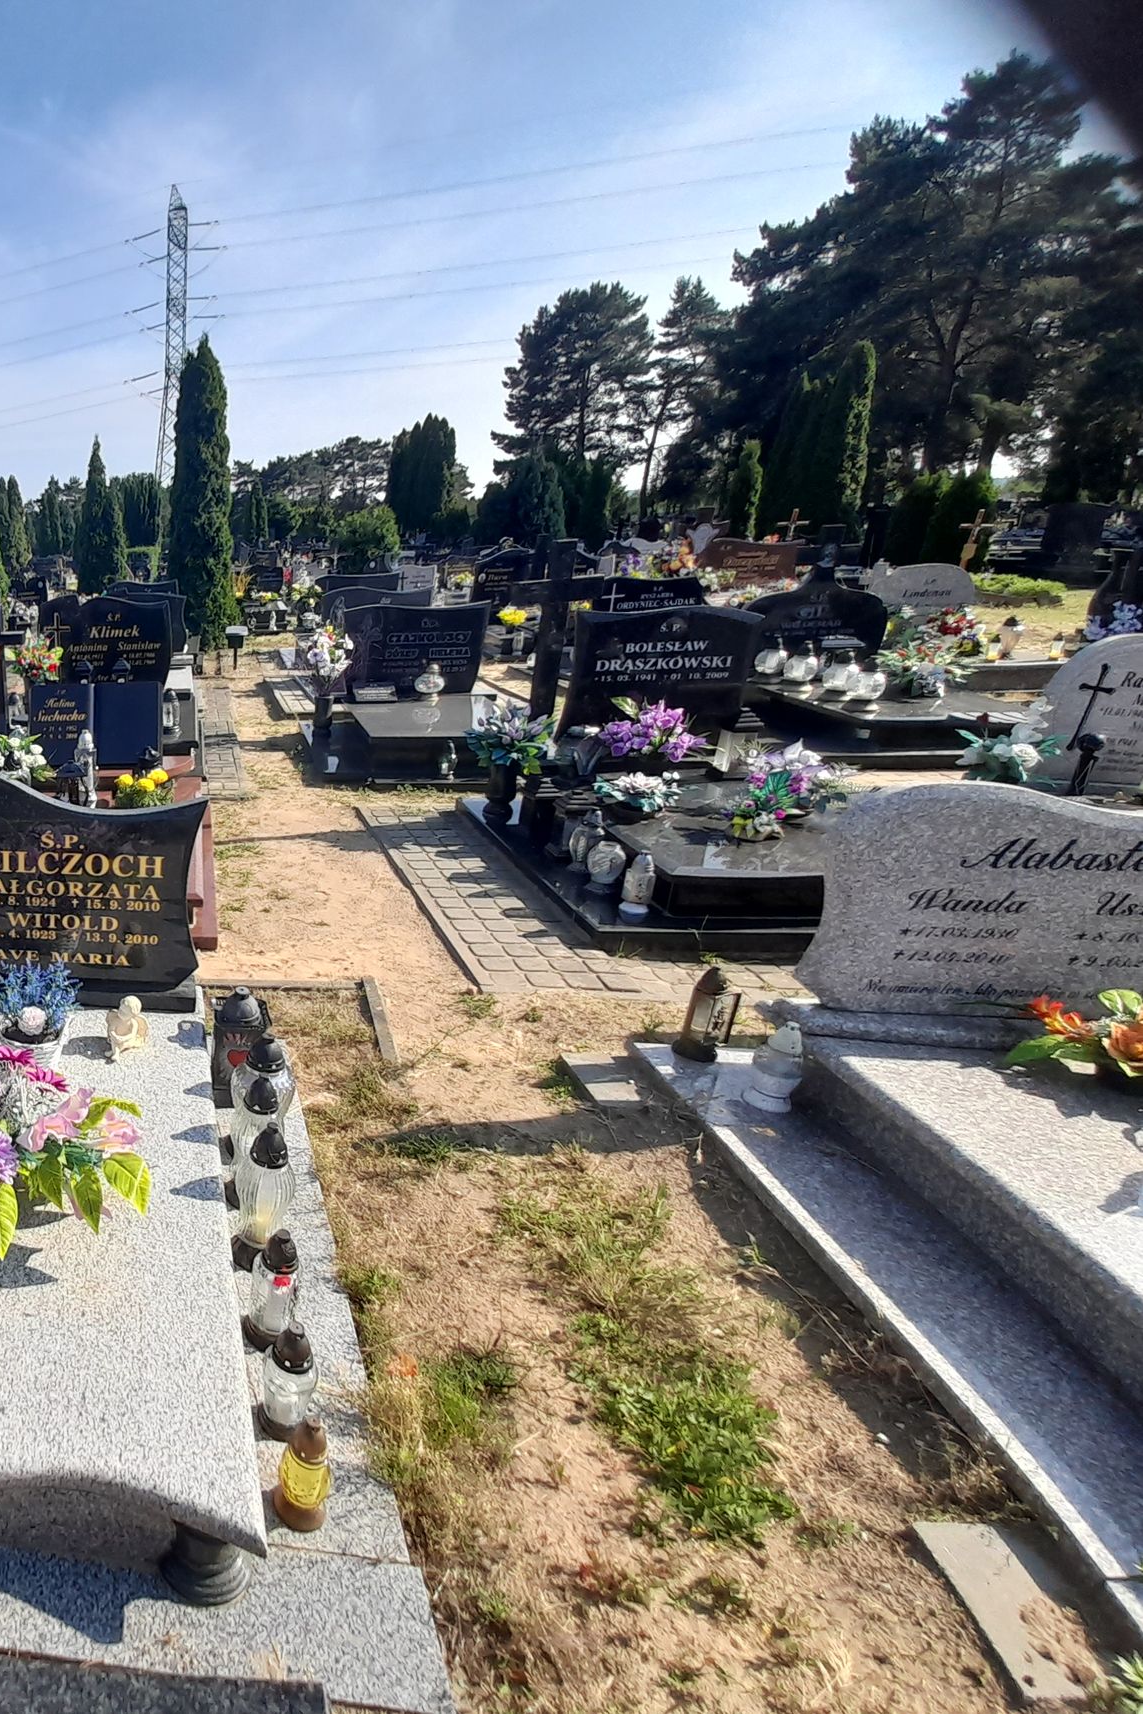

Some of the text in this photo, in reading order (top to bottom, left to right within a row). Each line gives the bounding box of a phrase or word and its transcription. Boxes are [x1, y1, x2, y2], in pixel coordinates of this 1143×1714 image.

[89, 624, 141, 639] Klimek
[624, 639, 710, 654] BOLESŁAW
[25, 896, 57, 907] 1924
[126, 900, 161, 912] 2010
[907, 888, 1029, 915] Wanda
[7, 912, 120, 932] WITOLD
[125, 933, 159, 945] 2010
[50, 951, 131, 967] MARIA
